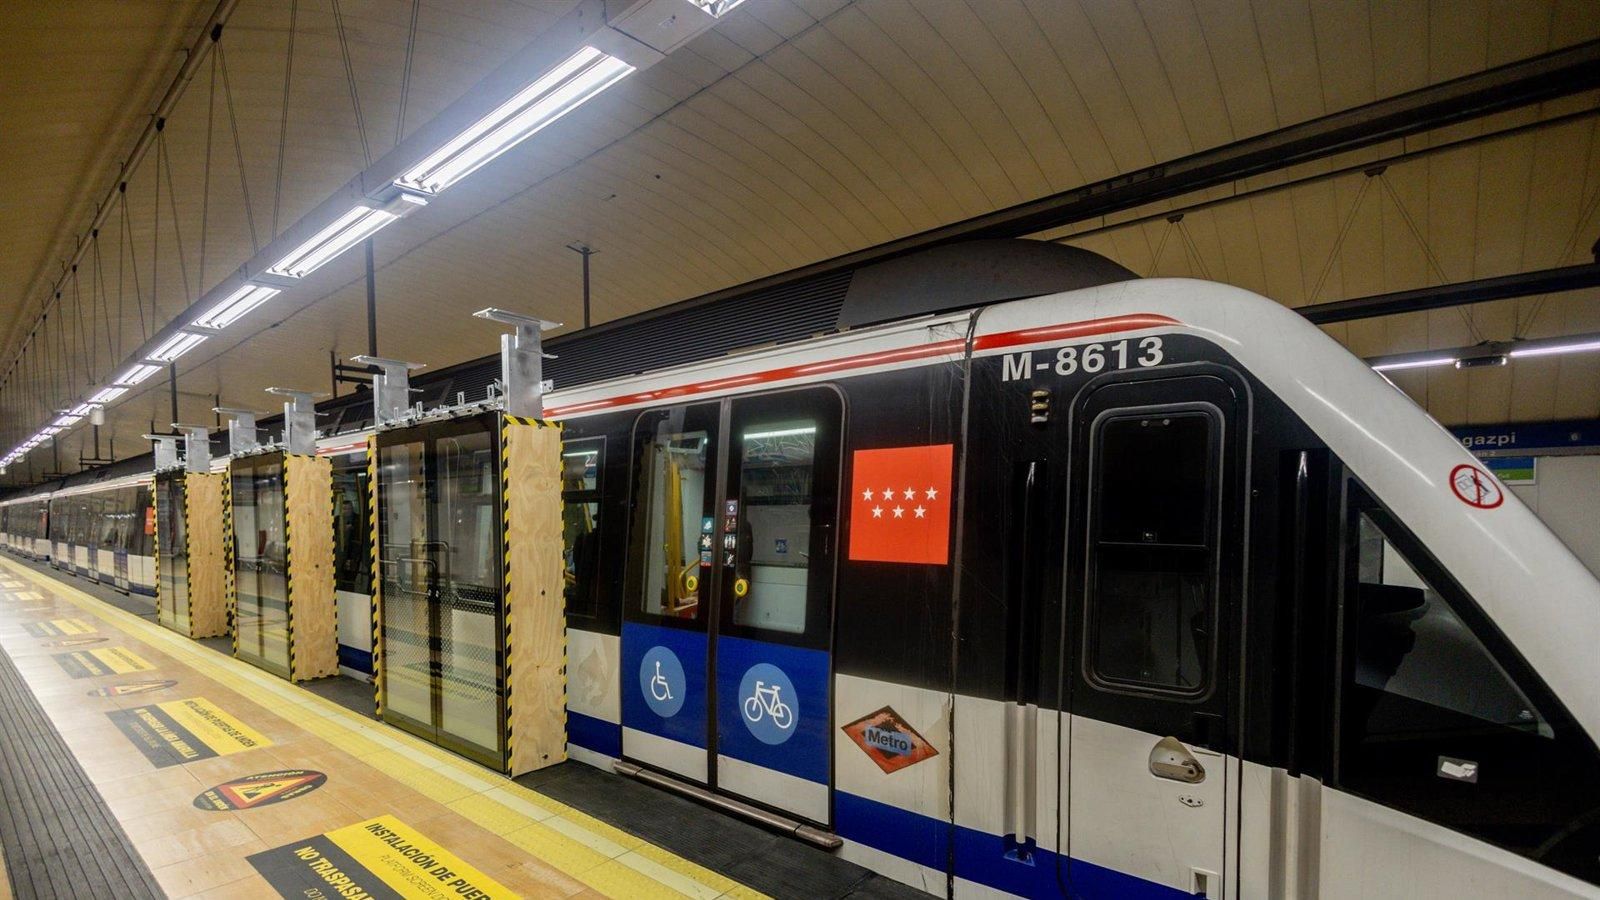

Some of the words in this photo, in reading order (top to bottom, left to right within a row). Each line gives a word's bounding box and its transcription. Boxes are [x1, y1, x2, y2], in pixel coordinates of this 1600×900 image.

[1002, 337, 1164, 381] M-8613
[1458, 432, 1516, 447] gazpi
[868, 729, 908, 751] Metro
[293, 846, 320, 860] NO
[364, 822, 440, 870] INSTALACIÓN
[429, 866, 457, 882] DE
